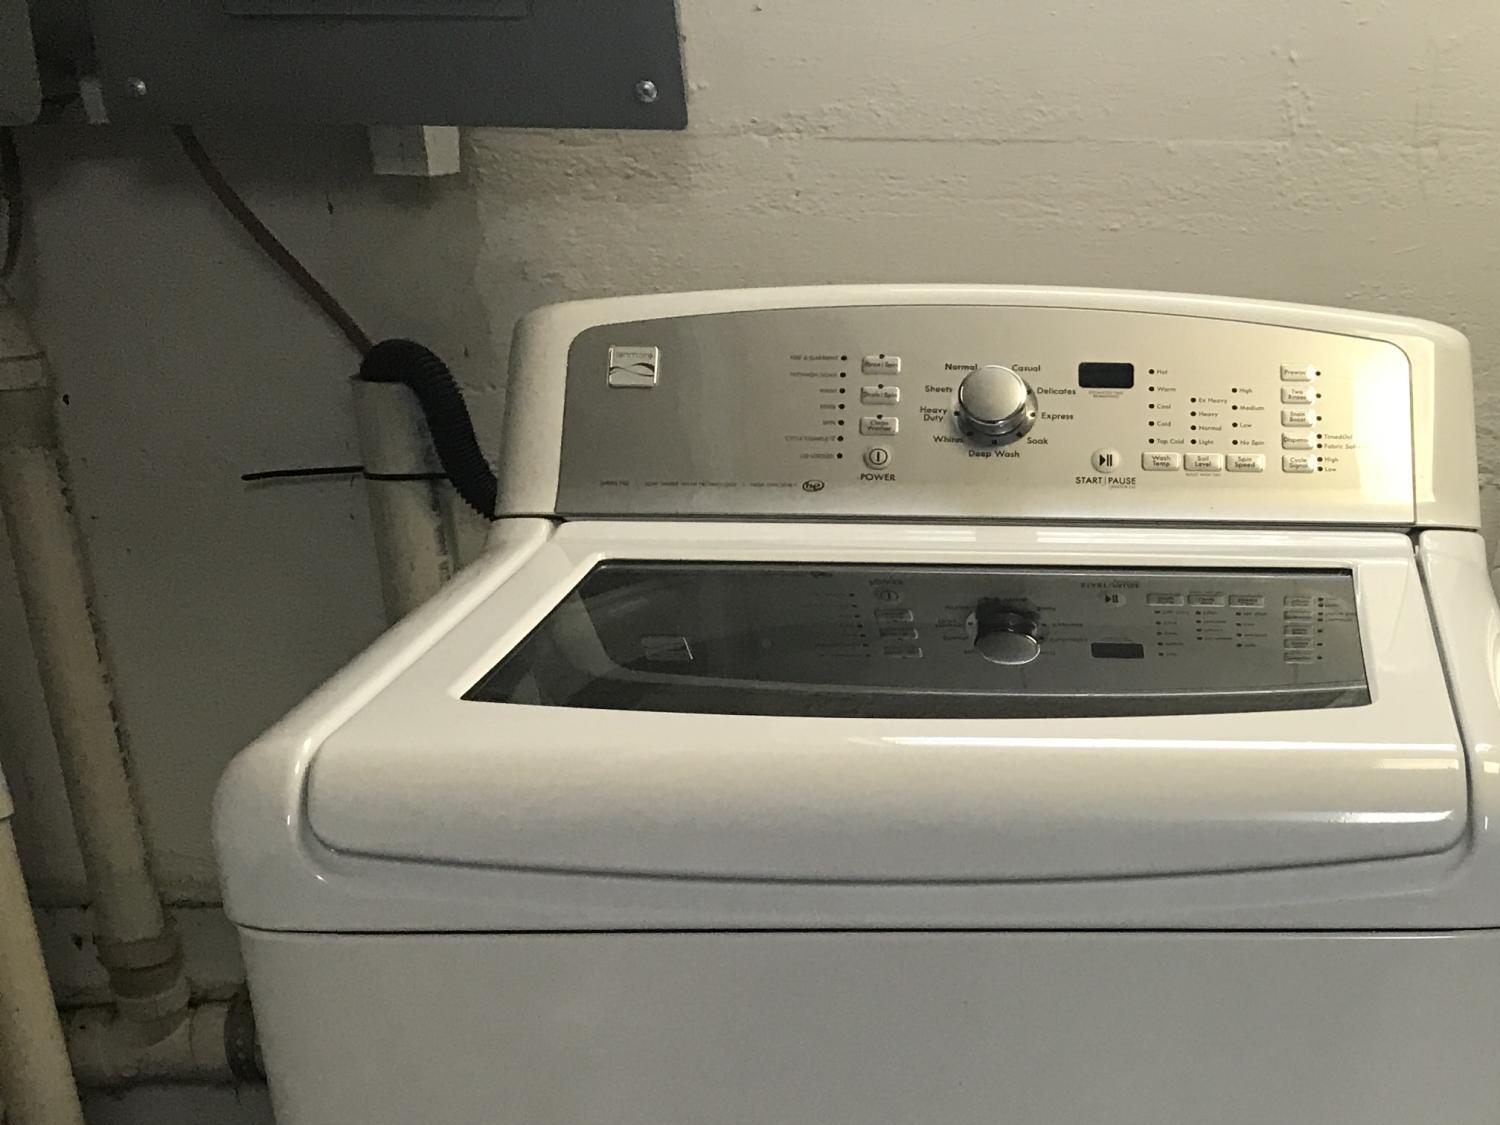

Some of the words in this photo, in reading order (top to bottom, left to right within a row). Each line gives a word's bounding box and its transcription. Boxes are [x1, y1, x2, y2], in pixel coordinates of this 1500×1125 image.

[945, 363, 978, 371] Normal
[1012, 364, 1041, 372] Casual
[925, 385, 953, 393] Sheets
[1037, 387, 1077, 395] Delicates
[920, 406, 948, 415] Heavy
[923, 414, 944, 423] Duty
[1041, 413, 1074, 421] Express
[968, 450, 991, 458] Deep
[995, 450, 1020, 458] Wash
[860, 473, 896, 481] POWER
